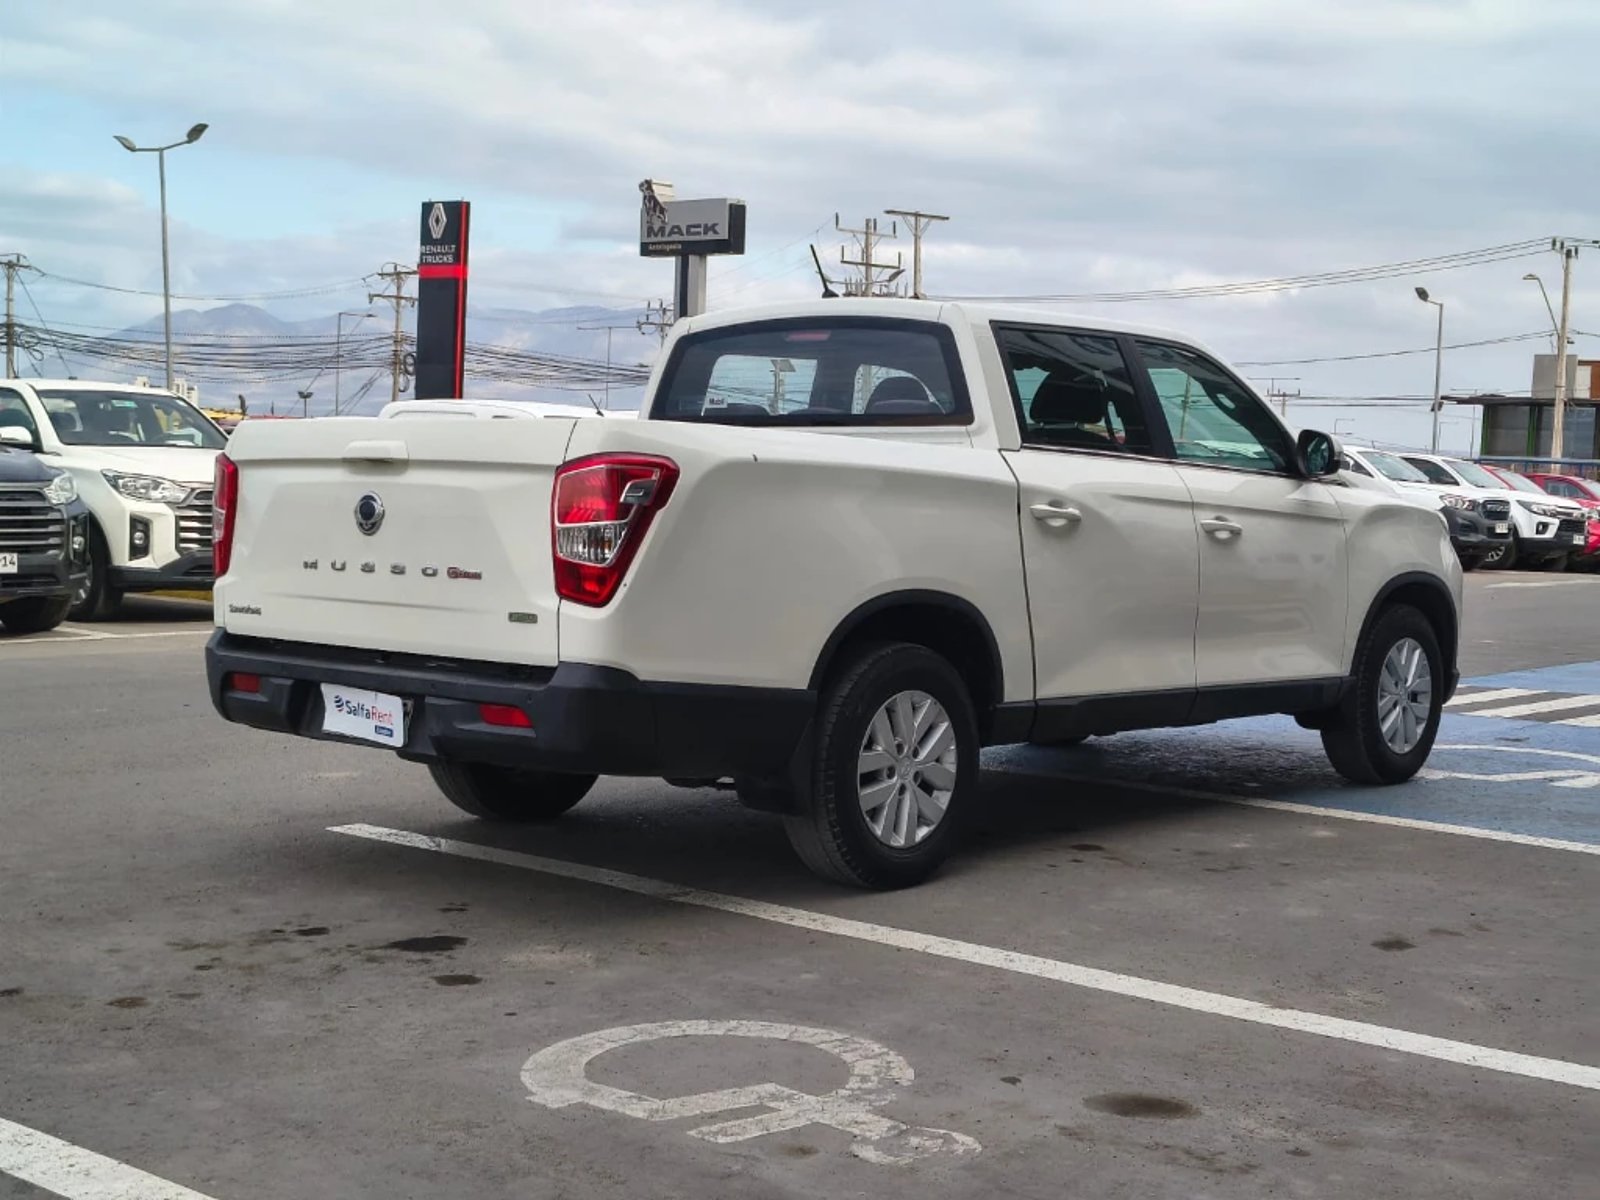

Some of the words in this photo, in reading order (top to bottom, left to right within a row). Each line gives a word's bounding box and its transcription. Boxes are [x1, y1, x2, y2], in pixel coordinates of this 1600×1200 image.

[646, 223, 720, 238] MACK
[421, 245, 456, 253] RENAULT
[423, 255, 454, 263] TRUCKS
[303, 560, 439, 577] MUSSO
